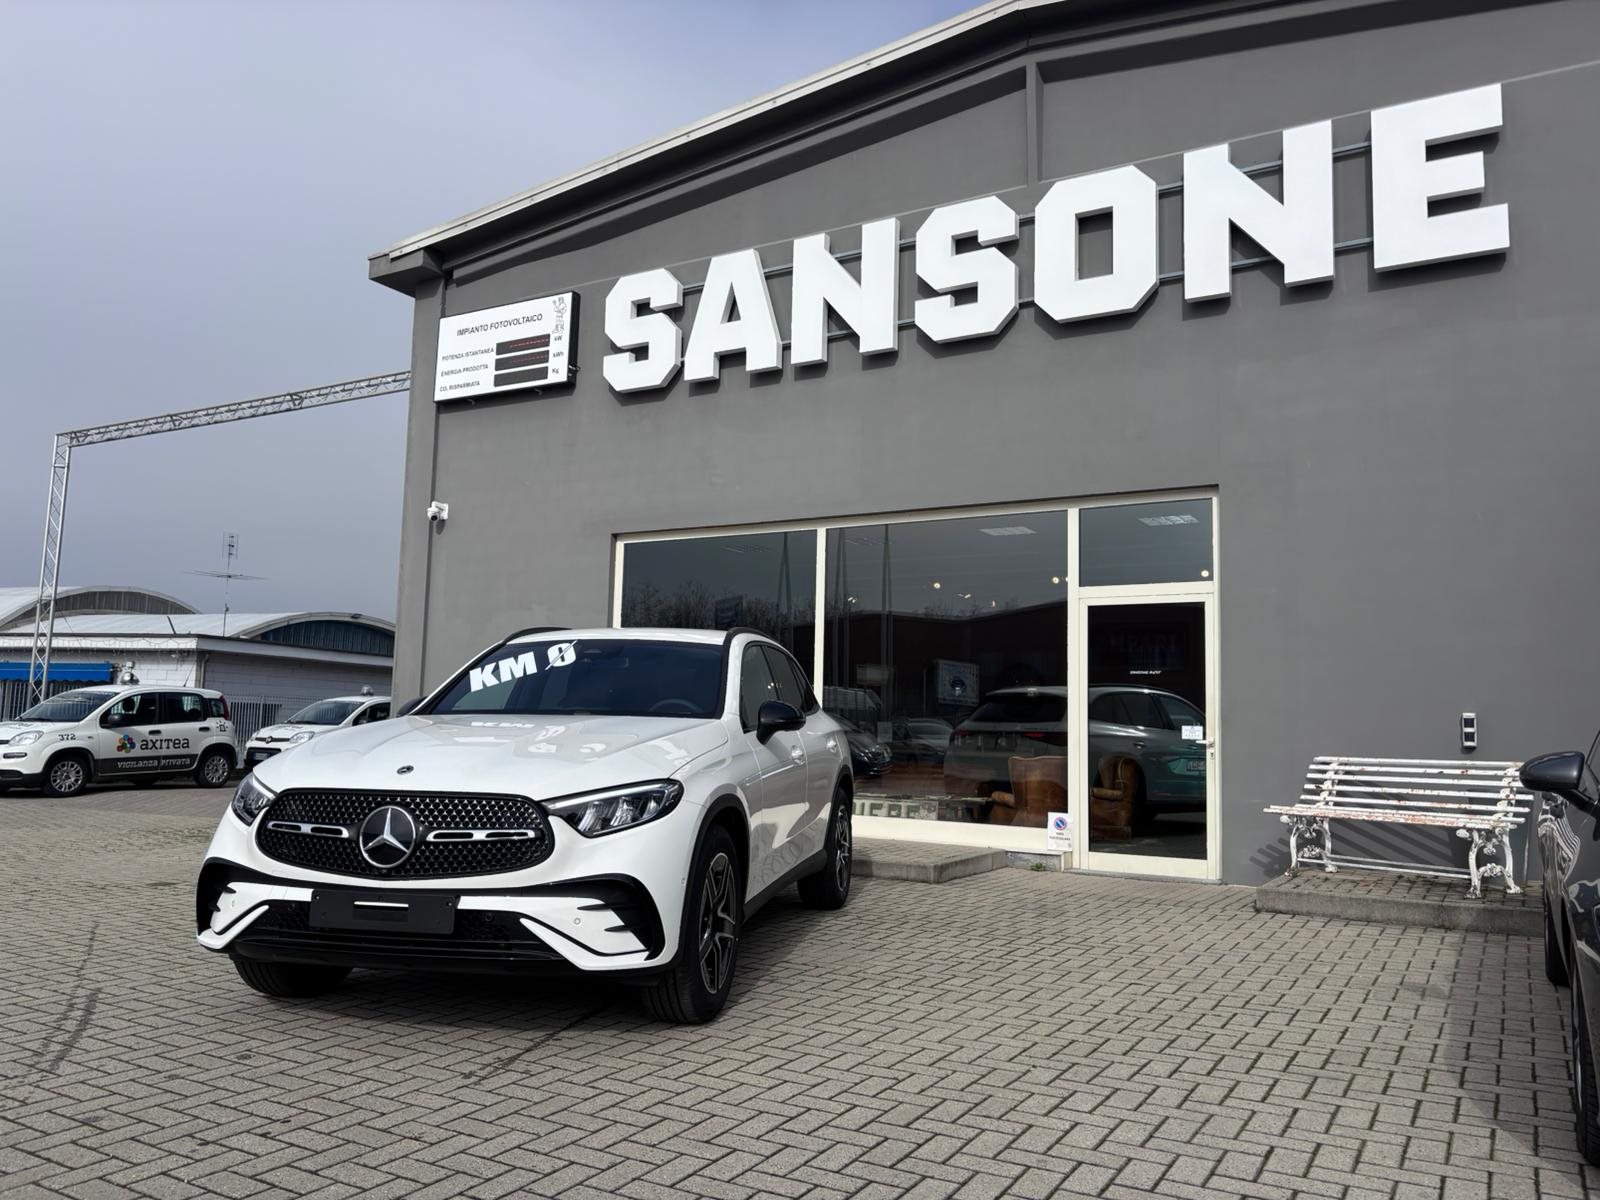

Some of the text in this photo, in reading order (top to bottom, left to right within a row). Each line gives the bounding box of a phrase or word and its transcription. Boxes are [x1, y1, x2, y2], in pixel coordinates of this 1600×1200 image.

[602, 83, 1510, 394] SANSONE
[456, 313, 543, 336] IMPIANTO FOTOVOLTAICO
[442, 347, 494, 361] POTENZA ISTANTANEA
[441, 364, 488, 377] ENERGIA PRODOTTA
[469, 651, 537, 692] KM
[58, 733, 77, 741] 372
